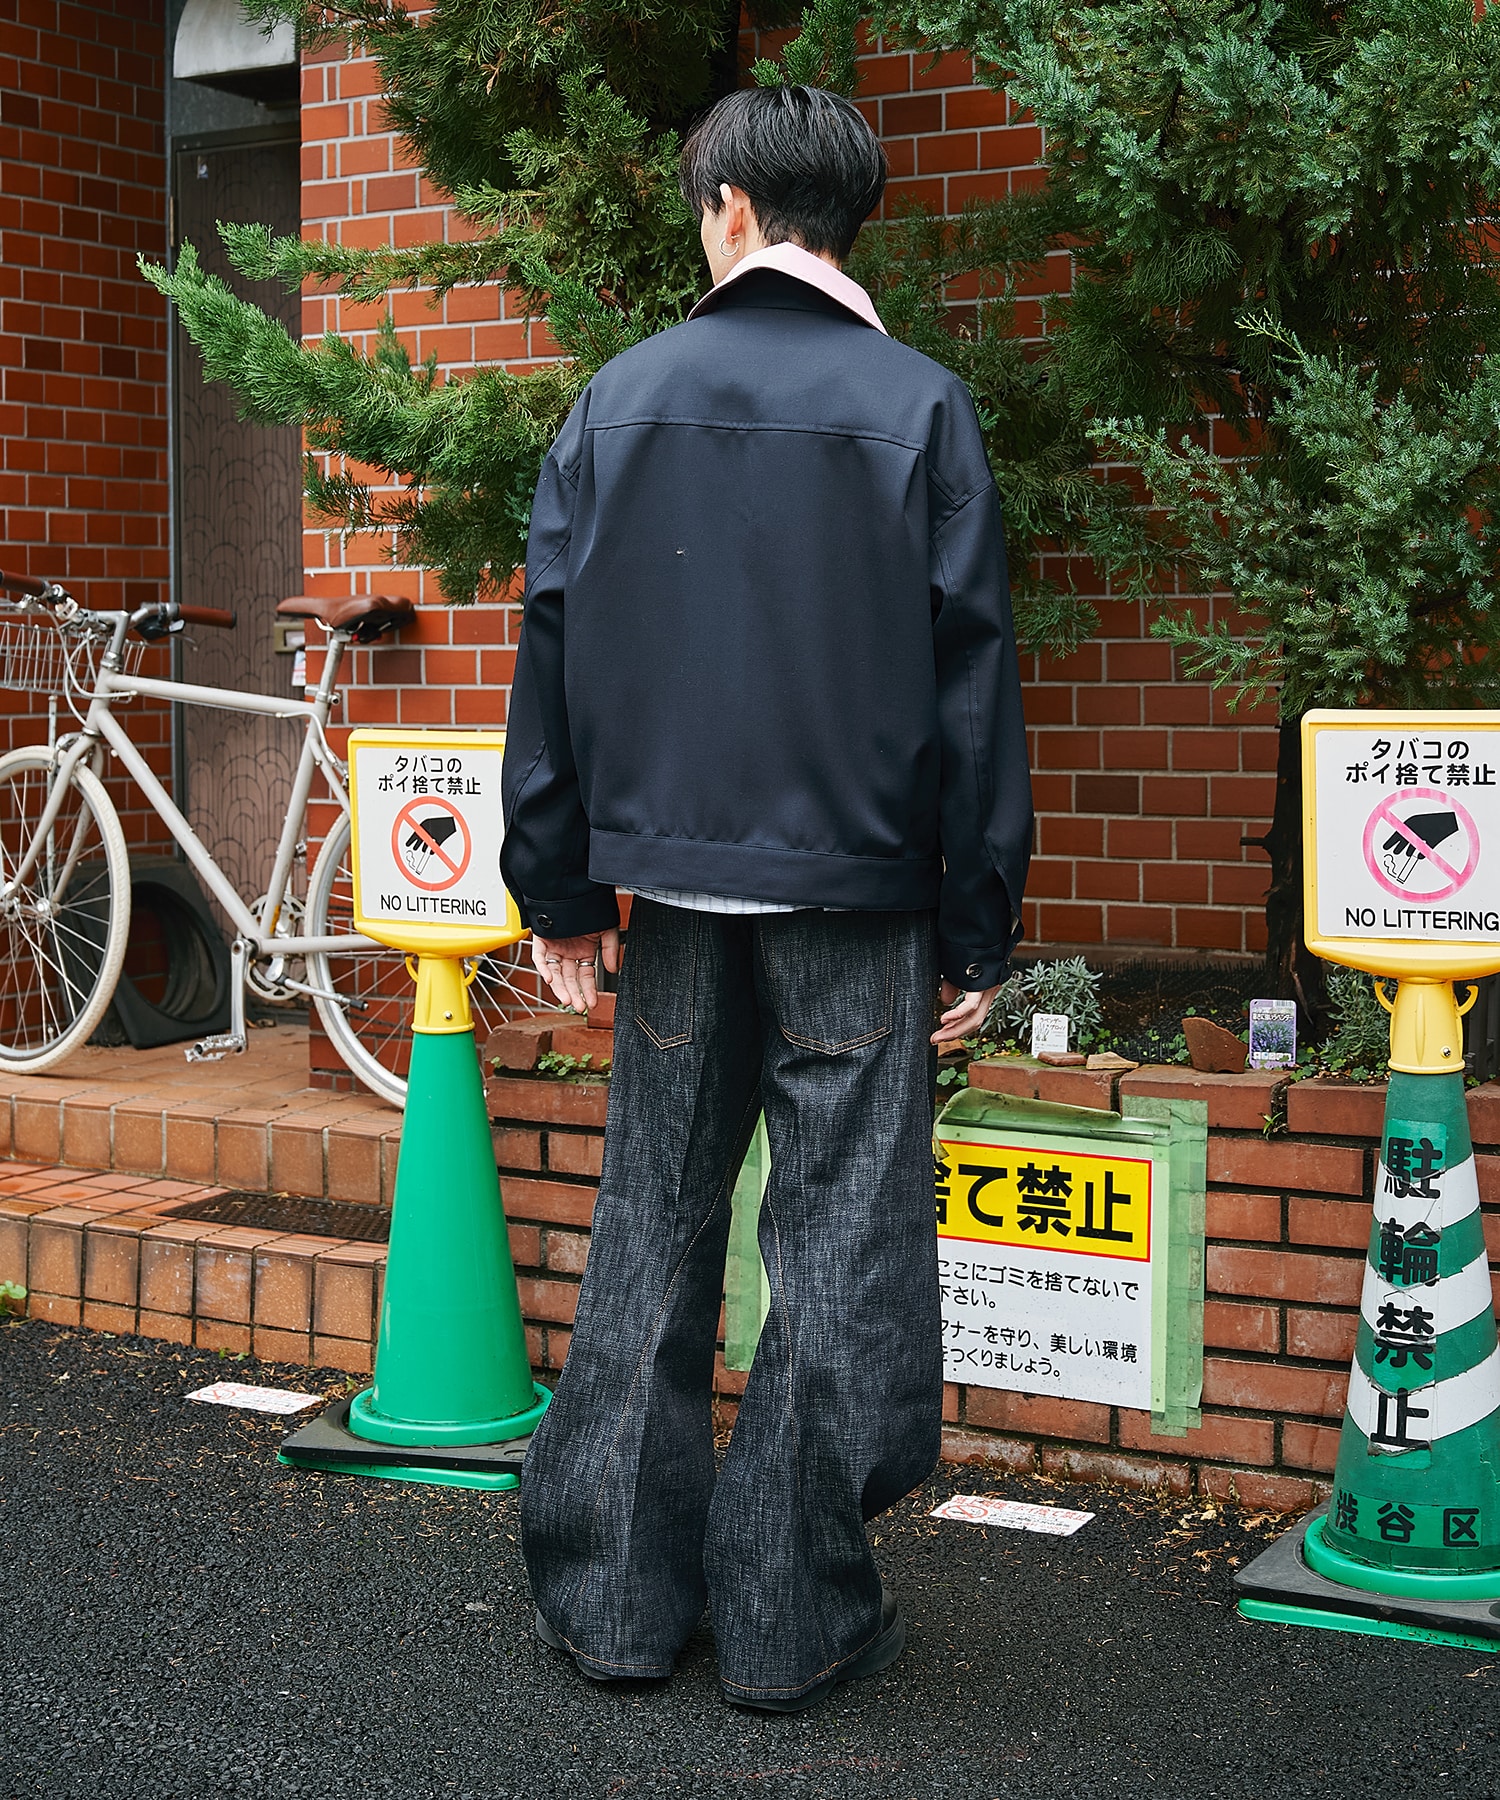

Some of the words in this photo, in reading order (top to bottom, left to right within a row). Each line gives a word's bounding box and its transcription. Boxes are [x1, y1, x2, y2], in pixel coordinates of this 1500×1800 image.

[1371, 737, 1469, 760] タバコの
[394, 754, 462, 773] タバコの
[1345, 761, 1497, 786] ポイ捨て禁止
[378, 774, 482, 795] ポイ捨て禁止
[380, 894, 402, 911] NO
[406, 896, 487, 916] LITTERING
[1345, 907, 1376, 928] NO
[1383, 909, 1500, 932] LITTERING
[934, 1157, 1134, 1243] て禁止
[937, 1259, 1139, 1301] ここにゴミを捨てないで
[1370, 1137, 1443, 1450] 駐輪禁止
[1335, 1488, 1480, 1548] 渋谷区
